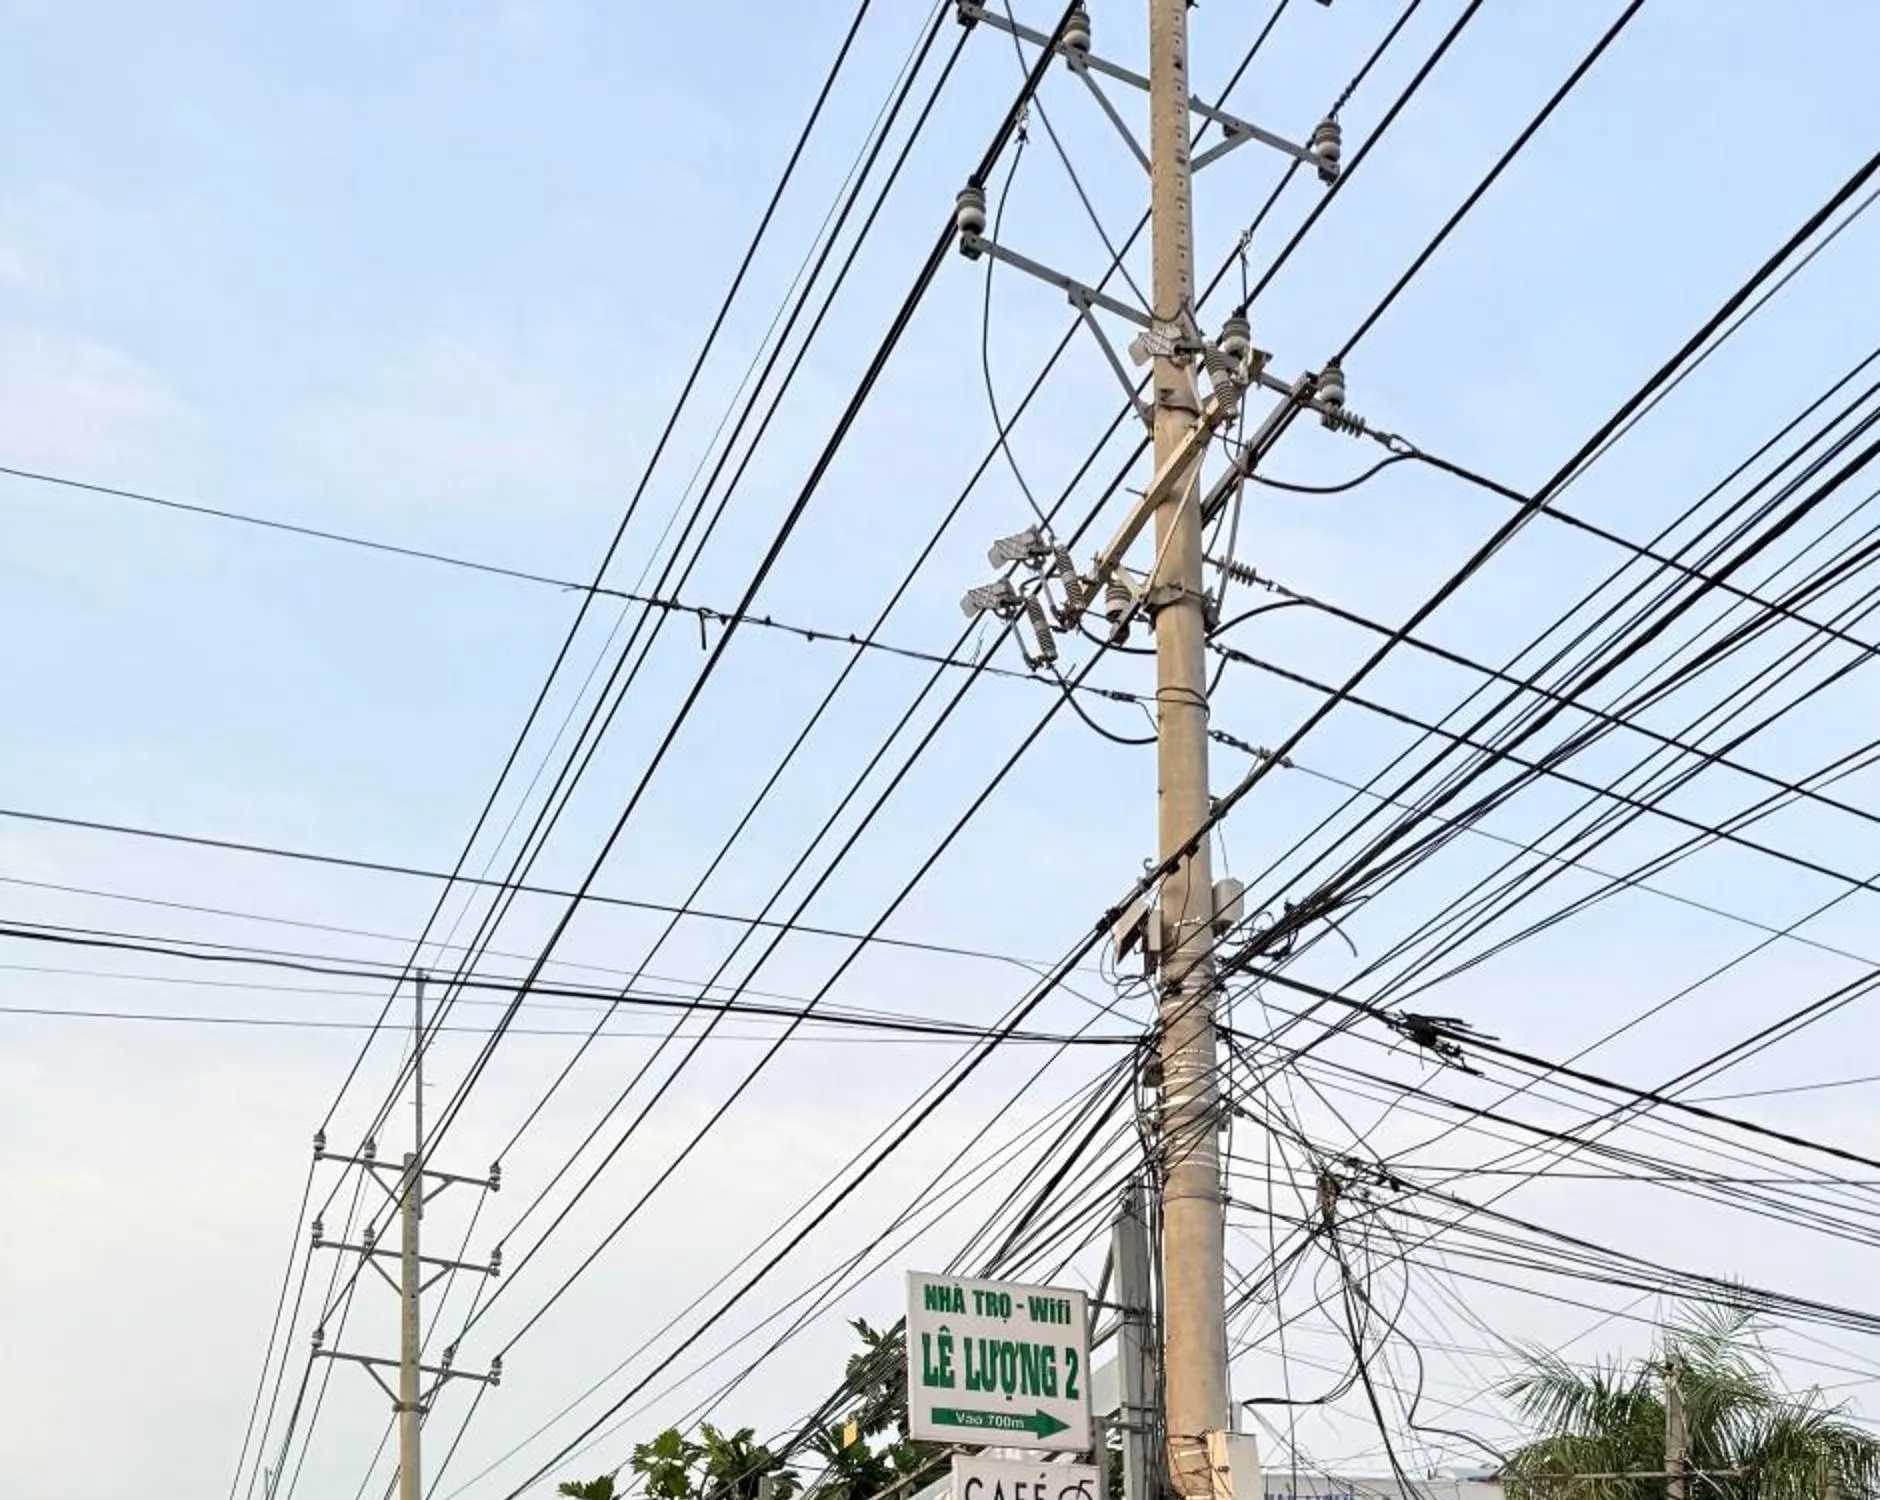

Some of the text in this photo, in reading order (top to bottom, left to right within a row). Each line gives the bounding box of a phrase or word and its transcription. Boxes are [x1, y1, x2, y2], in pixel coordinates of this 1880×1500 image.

[924, 1283, 966, 1314] NHÀ
[972, 1290, 1012, 1324] TRỌ
[921, 1325, 1080, 1401] LÊ LƯỢNG 2
